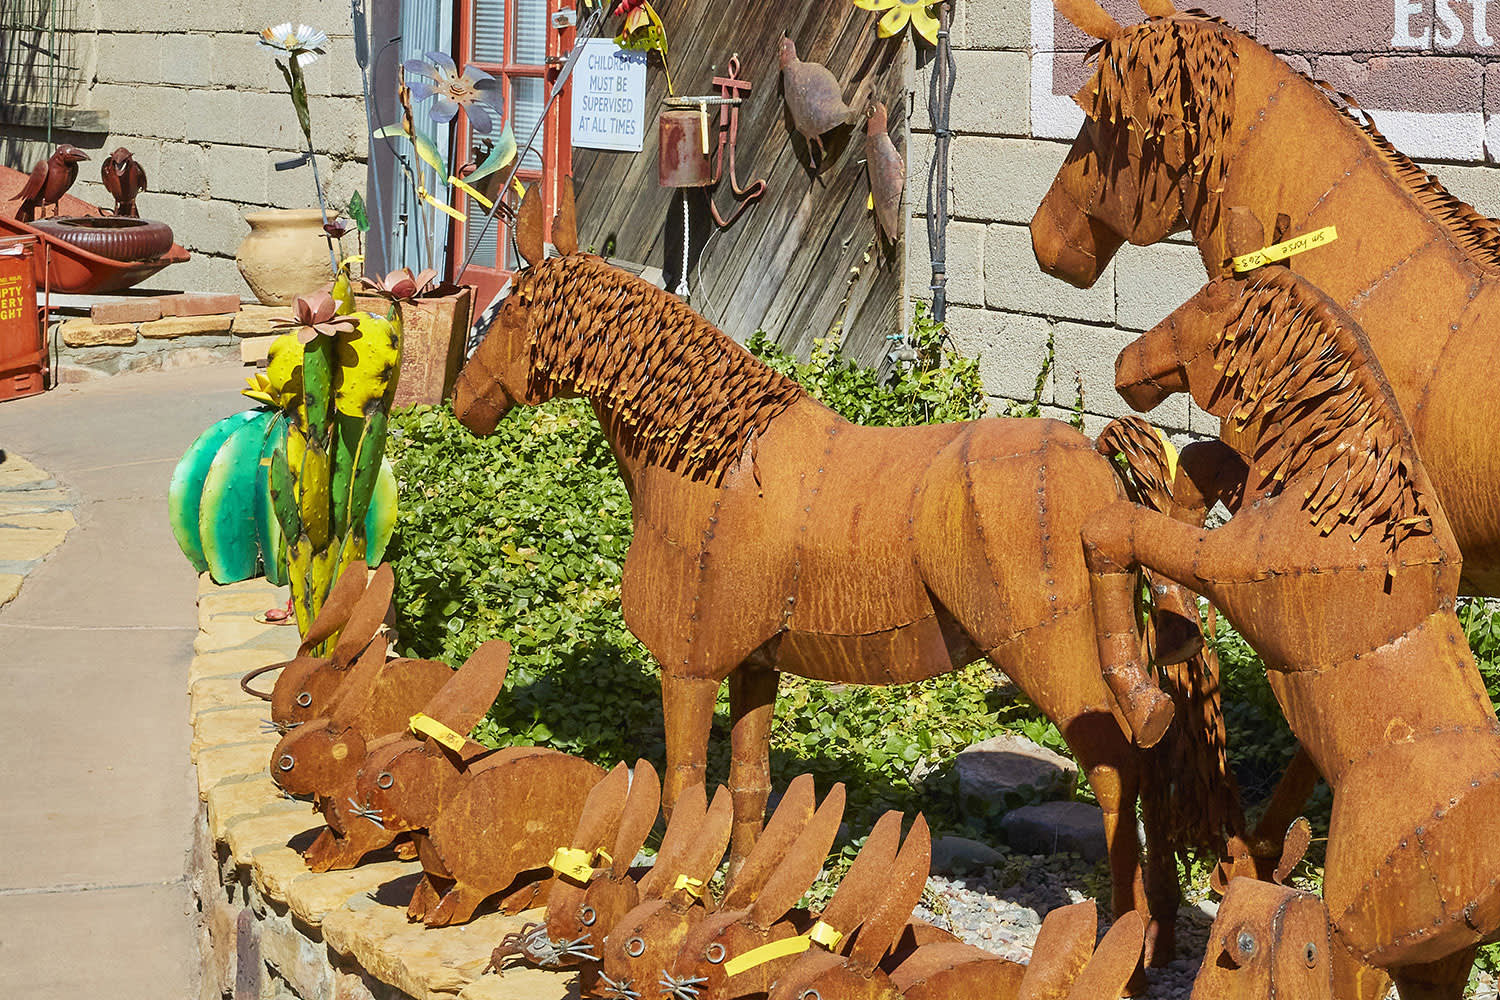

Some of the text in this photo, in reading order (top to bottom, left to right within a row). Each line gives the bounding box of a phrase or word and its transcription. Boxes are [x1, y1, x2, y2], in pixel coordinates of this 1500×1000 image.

[588, 54, 631, 71] CHILDREN
[589, 75, 628, 92] MUST BE
[582, 95, 633, 113] SUPERVISED
[579, 116, 636, 135] AT ALL TIMES
[0, 286, 22, 298] PTY
